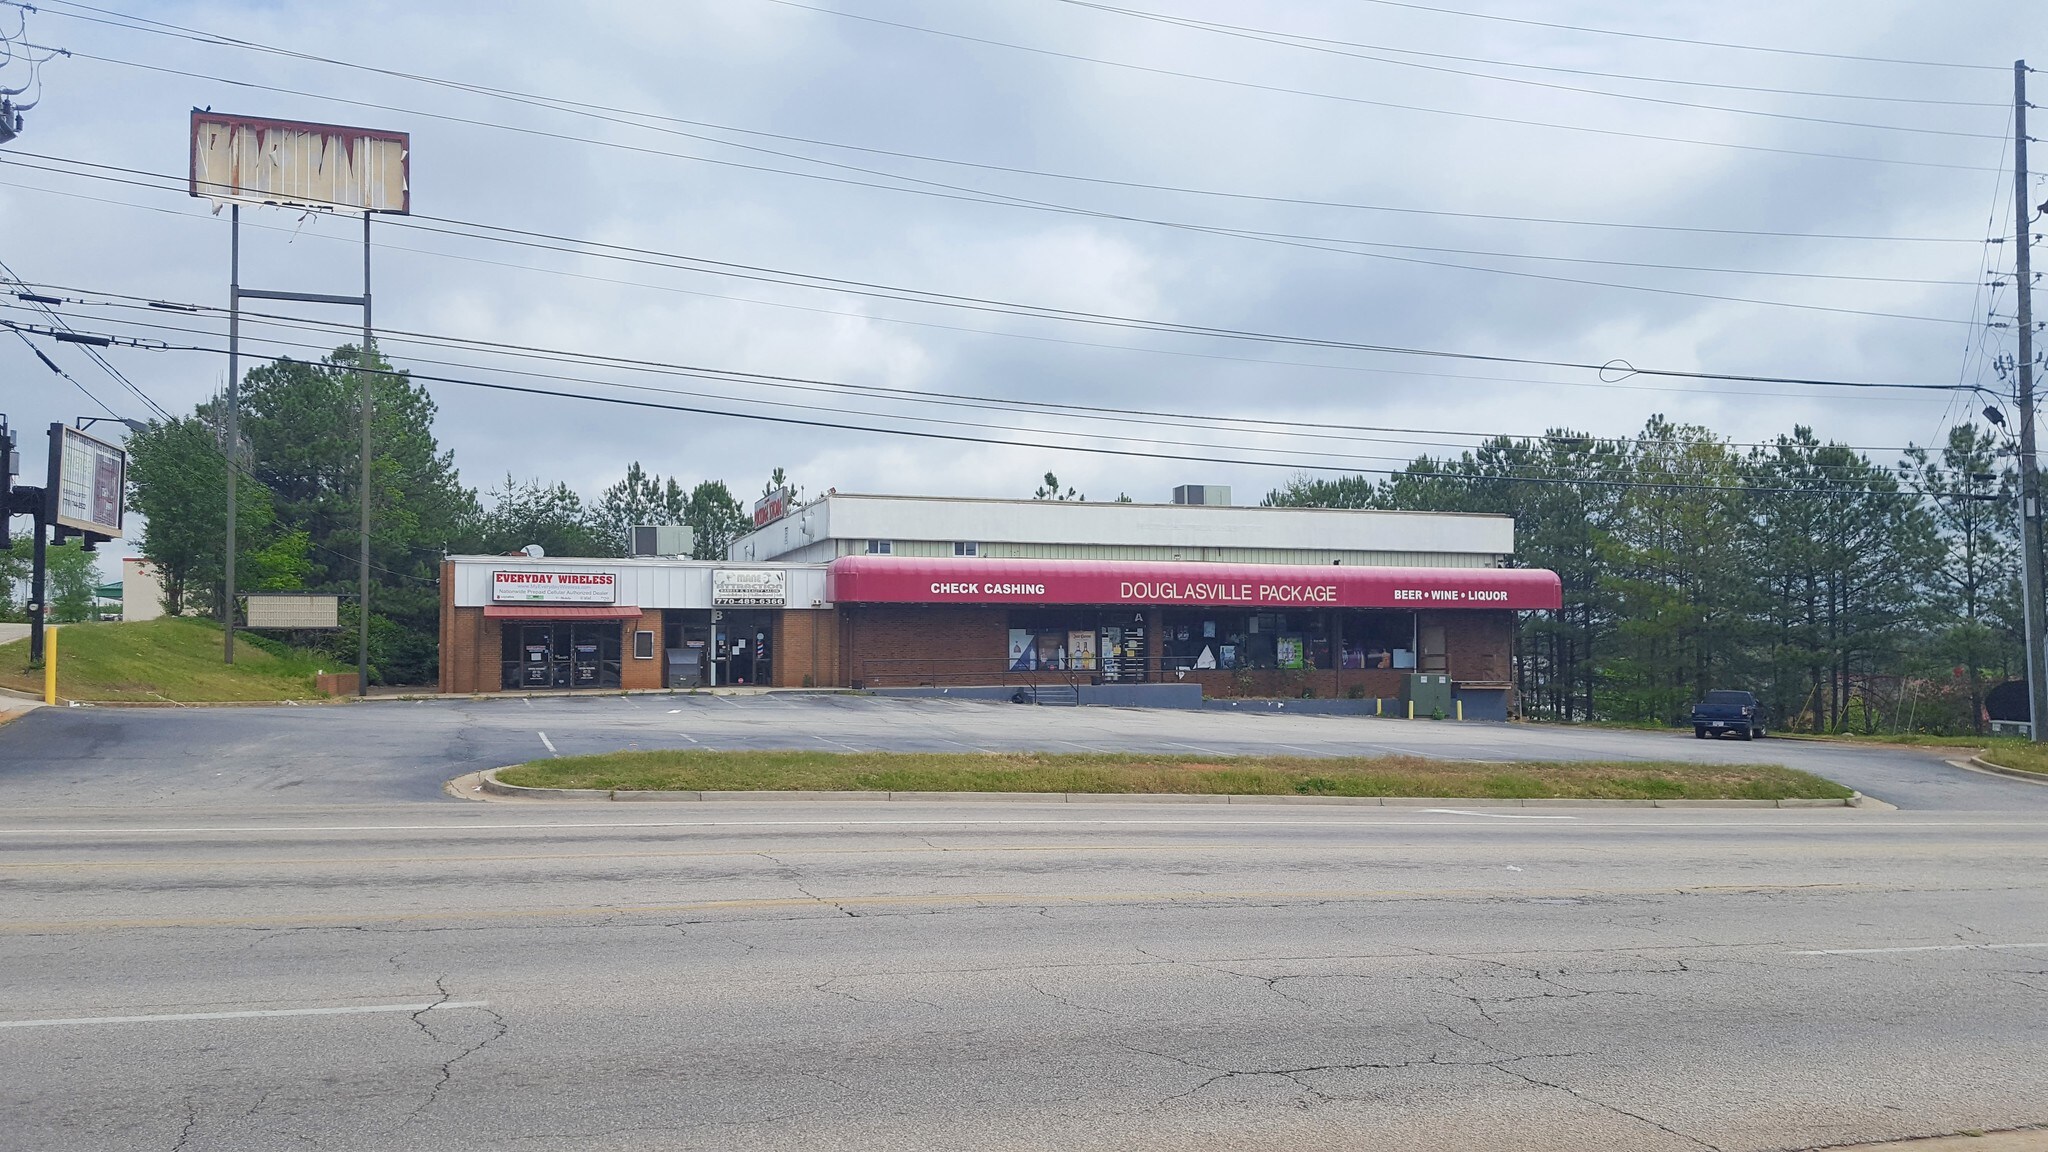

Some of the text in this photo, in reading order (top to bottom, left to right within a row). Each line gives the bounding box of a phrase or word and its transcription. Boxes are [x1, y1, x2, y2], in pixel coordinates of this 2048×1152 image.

[496, 574, 613, 585] EVERYDAY WIRELESS
[930, 583, 1045, 595] CHECK CASHING
[1120, 582, 1337, 601] DOUGLASVILLE PACKAGE
[1394, 590, 1508, 601] BEER WINE LIQUOR
[715, 611, 723, 621] B
[1135, 613, 1144, 622] A
